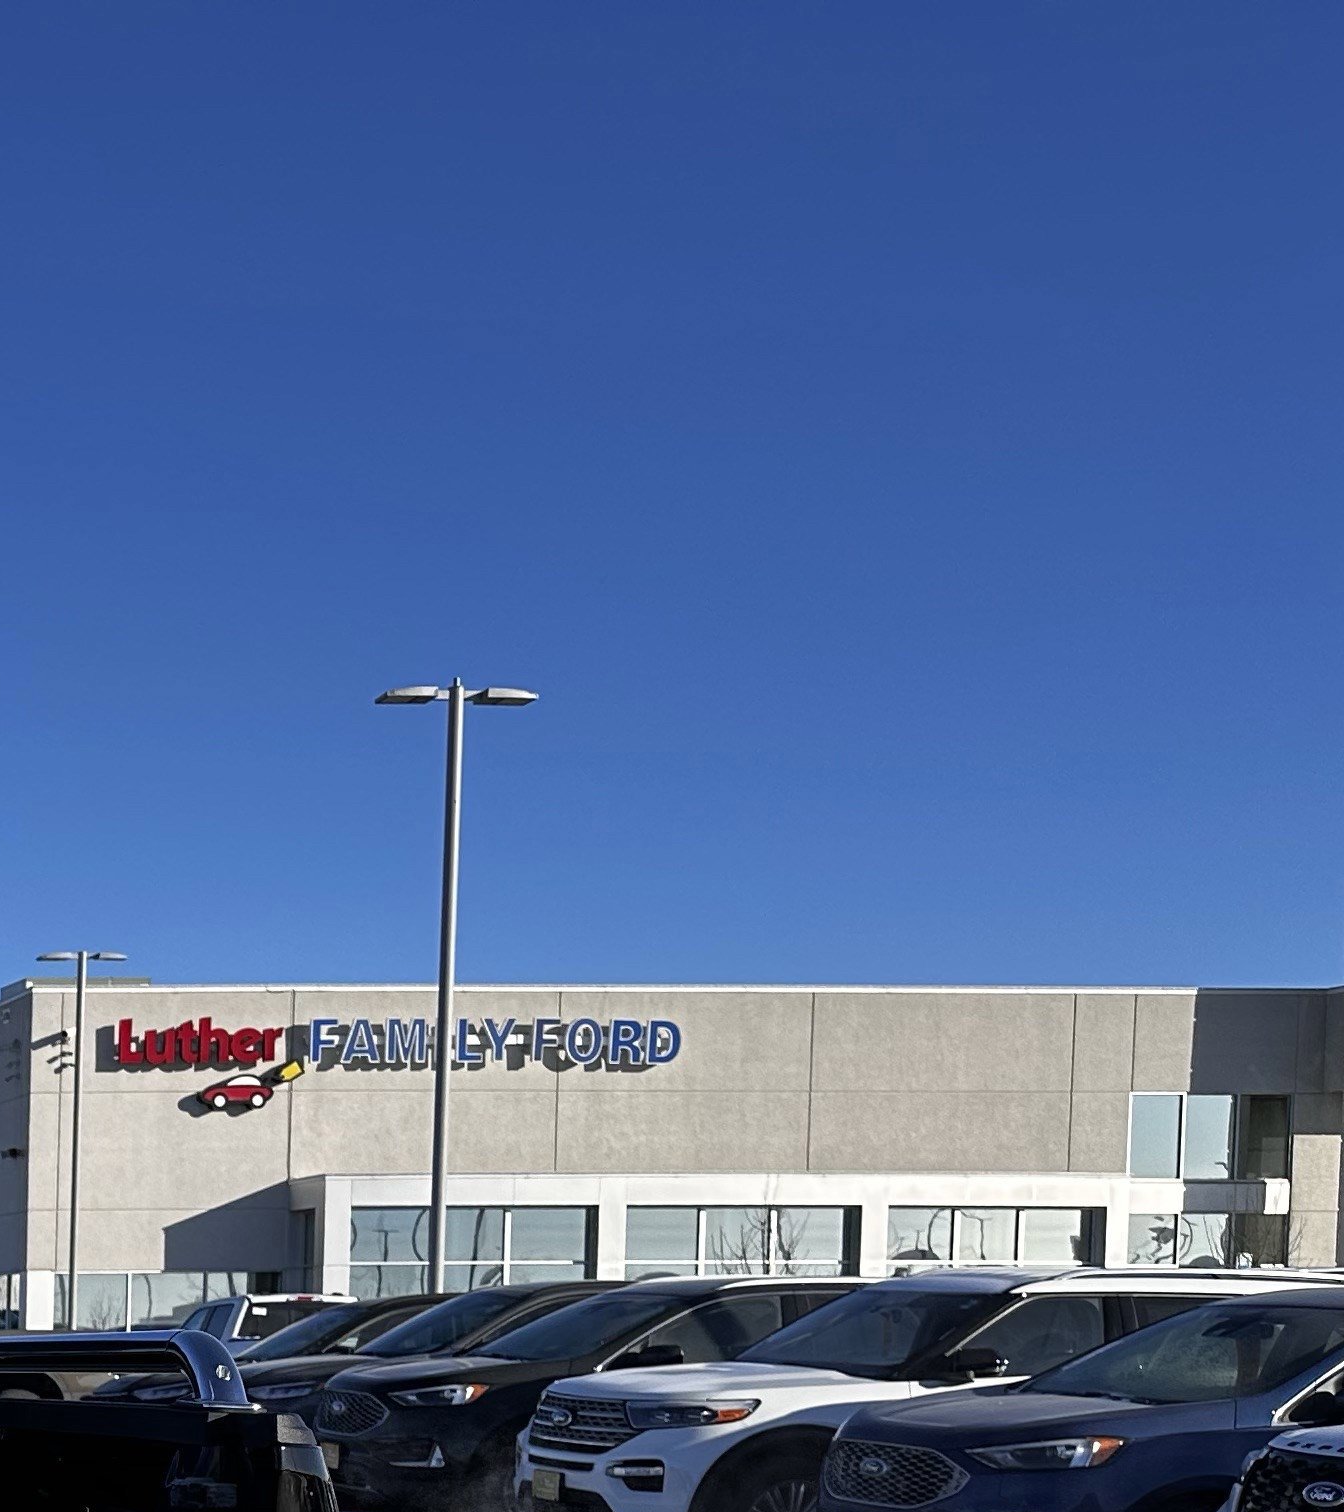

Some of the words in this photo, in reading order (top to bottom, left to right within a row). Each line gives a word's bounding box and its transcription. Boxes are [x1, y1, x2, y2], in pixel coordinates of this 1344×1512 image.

[118, 1016, 284, 1065] Luther
[310, 1017, 518, 1064] FAMLY
[532, 1017, 682, 1066] FORD
